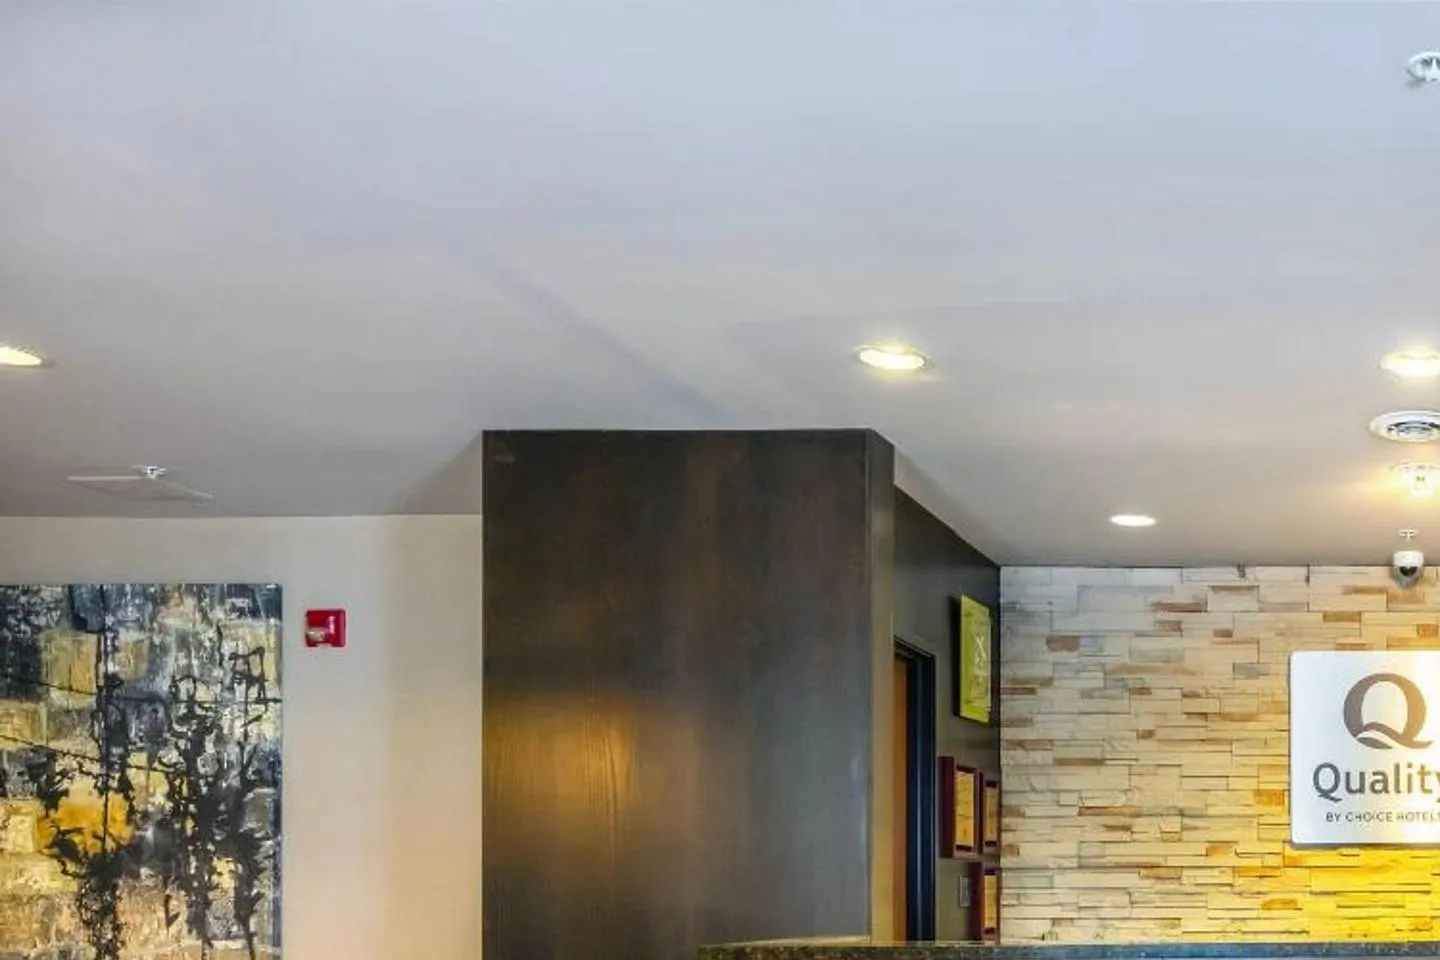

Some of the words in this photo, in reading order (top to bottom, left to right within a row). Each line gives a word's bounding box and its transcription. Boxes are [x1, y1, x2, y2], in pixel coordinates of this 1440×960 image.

[1343, 672, 1433, 750] Q
[1326, 811, 1341, 823] BY
[1345, 811, 1393, 823] CHOICE
